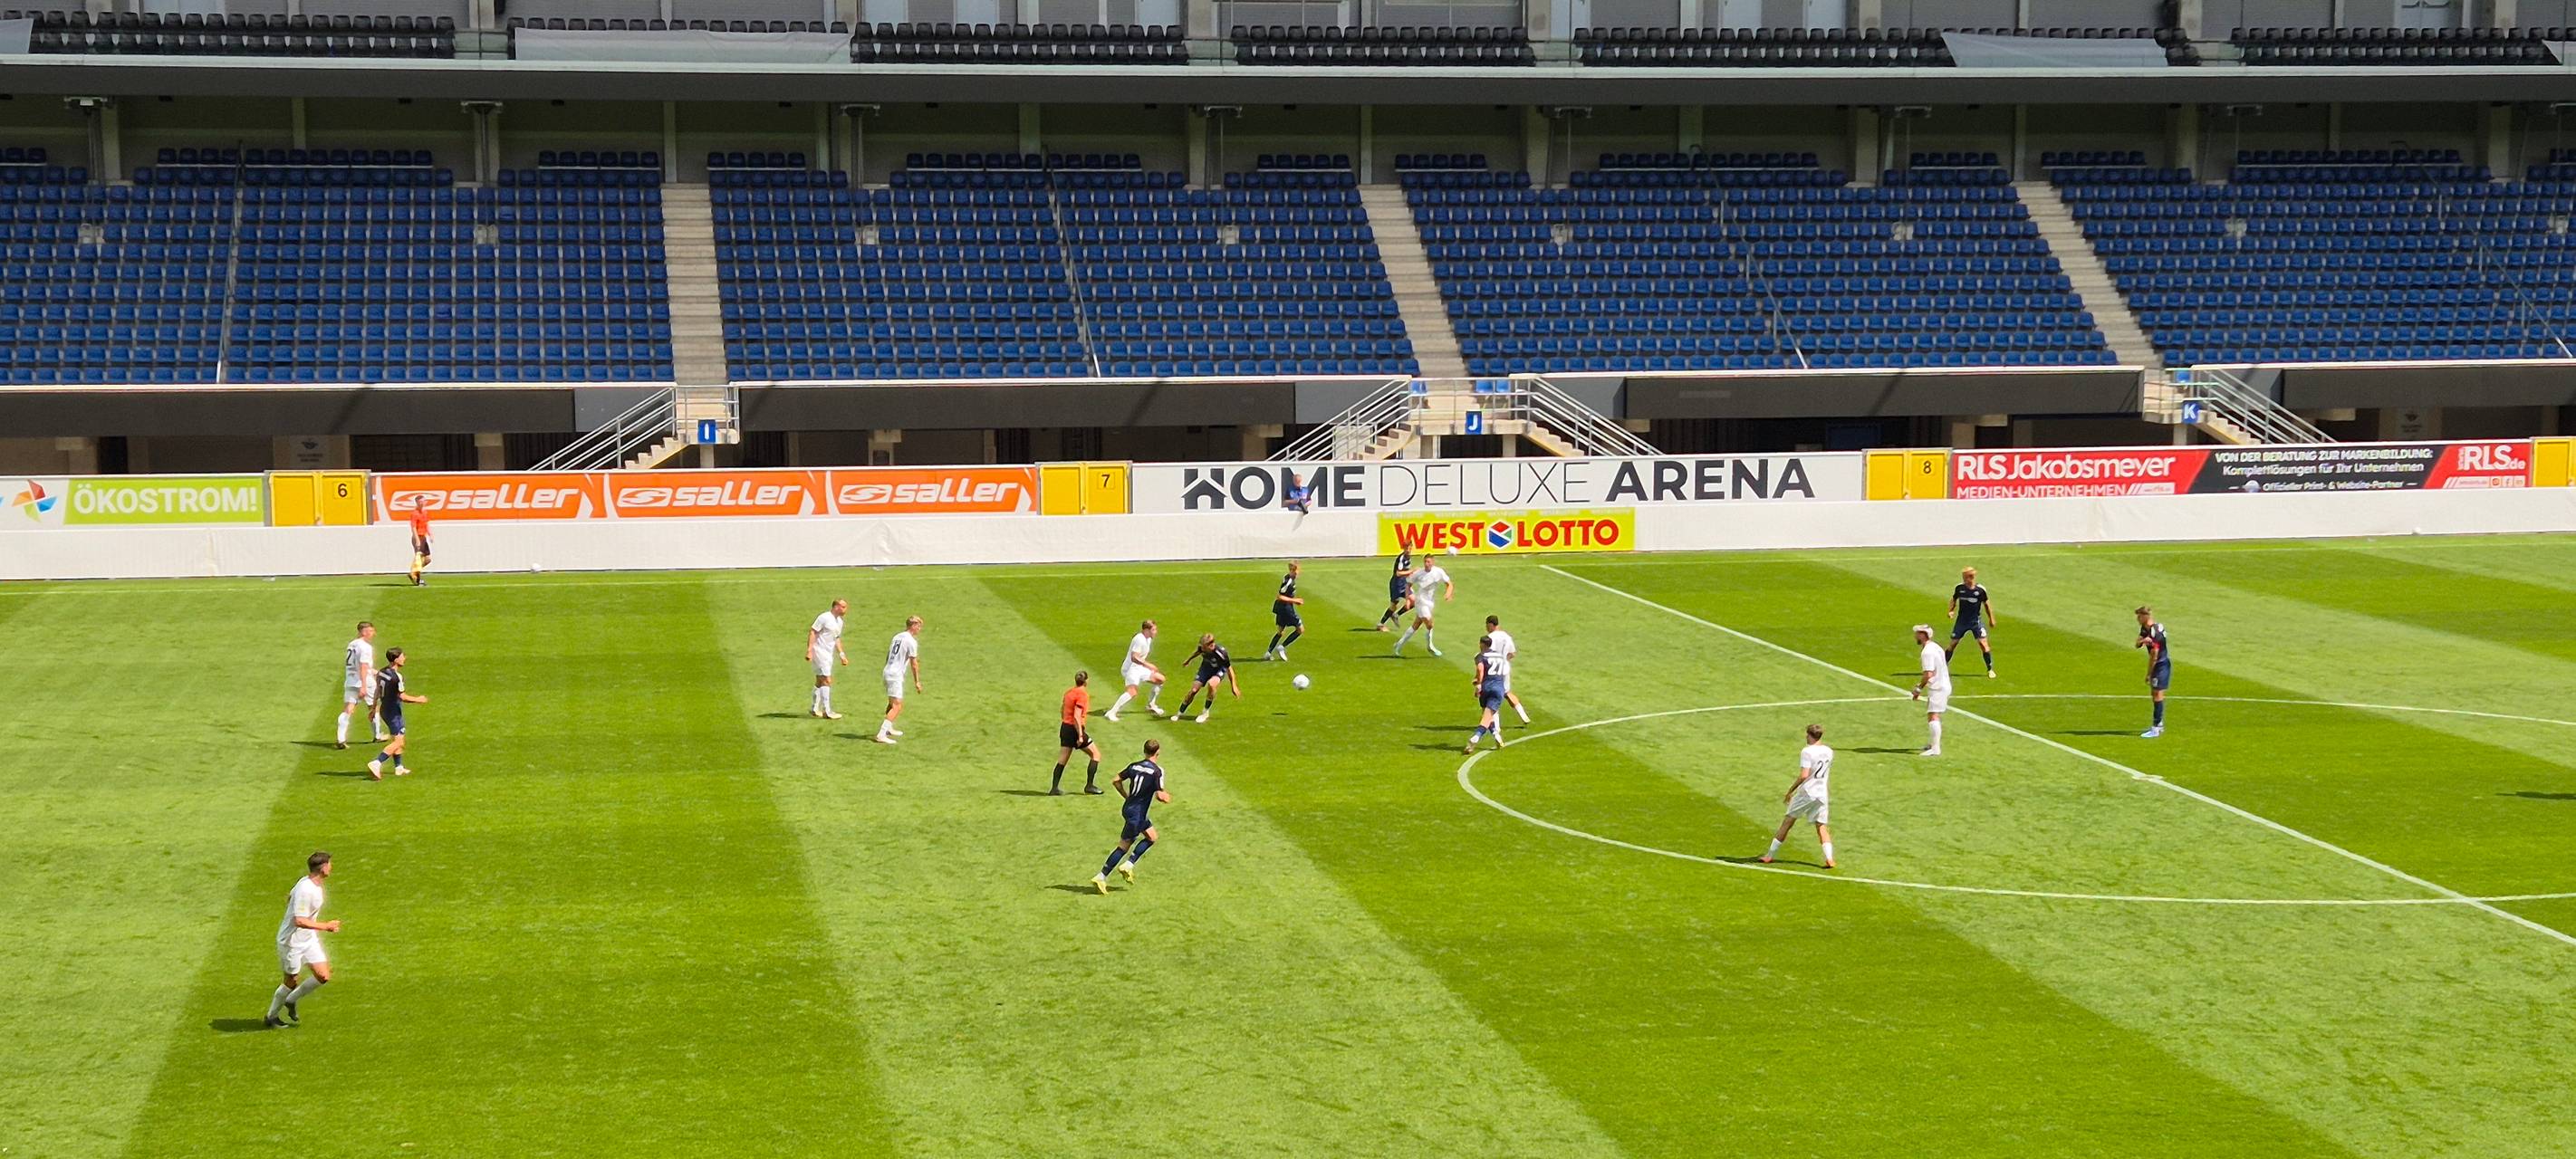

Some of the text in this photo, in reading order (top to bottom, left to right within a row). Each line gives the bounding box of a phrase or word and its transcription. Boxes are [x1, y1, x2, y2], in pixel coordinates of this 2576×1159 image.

[2184, 403, 2196, 419] K
[1467, 414, 1478, 431] J
[2215, 452, 2239, 463] VON
[2240, 452, 2262, 463] DER
[2263, 450, 2318, 462] BERATUNG
[2318, 450, 2340, 461] ZUR
[1923, 460, 1932, 474] 8
[1957, 455, 2177, 481] RLS Jakobsmeyer
[2223, 462, 2425, 477] Komplettlösungen für Ihr Unternehmen
[337, 483, 349, 498] 6
[1101, 473, 1111, 488] 7
[1379, 461, 1591, 507] DELUXE
[1605, 458, 1816, 503] ARENA
[73, 483, 257, 515] ÖKOSTROM!
[446, 484, 580, 510] saller
[672, 480, 803, 507] saller
[892, 478, 1019, 504] saller
[1956, 484, 2127, 499] MEDIEN-UNTERNEHMEN
[1517, 519, 1620, 548] LOTTO
[1131, 774, 1145, 797] 11
